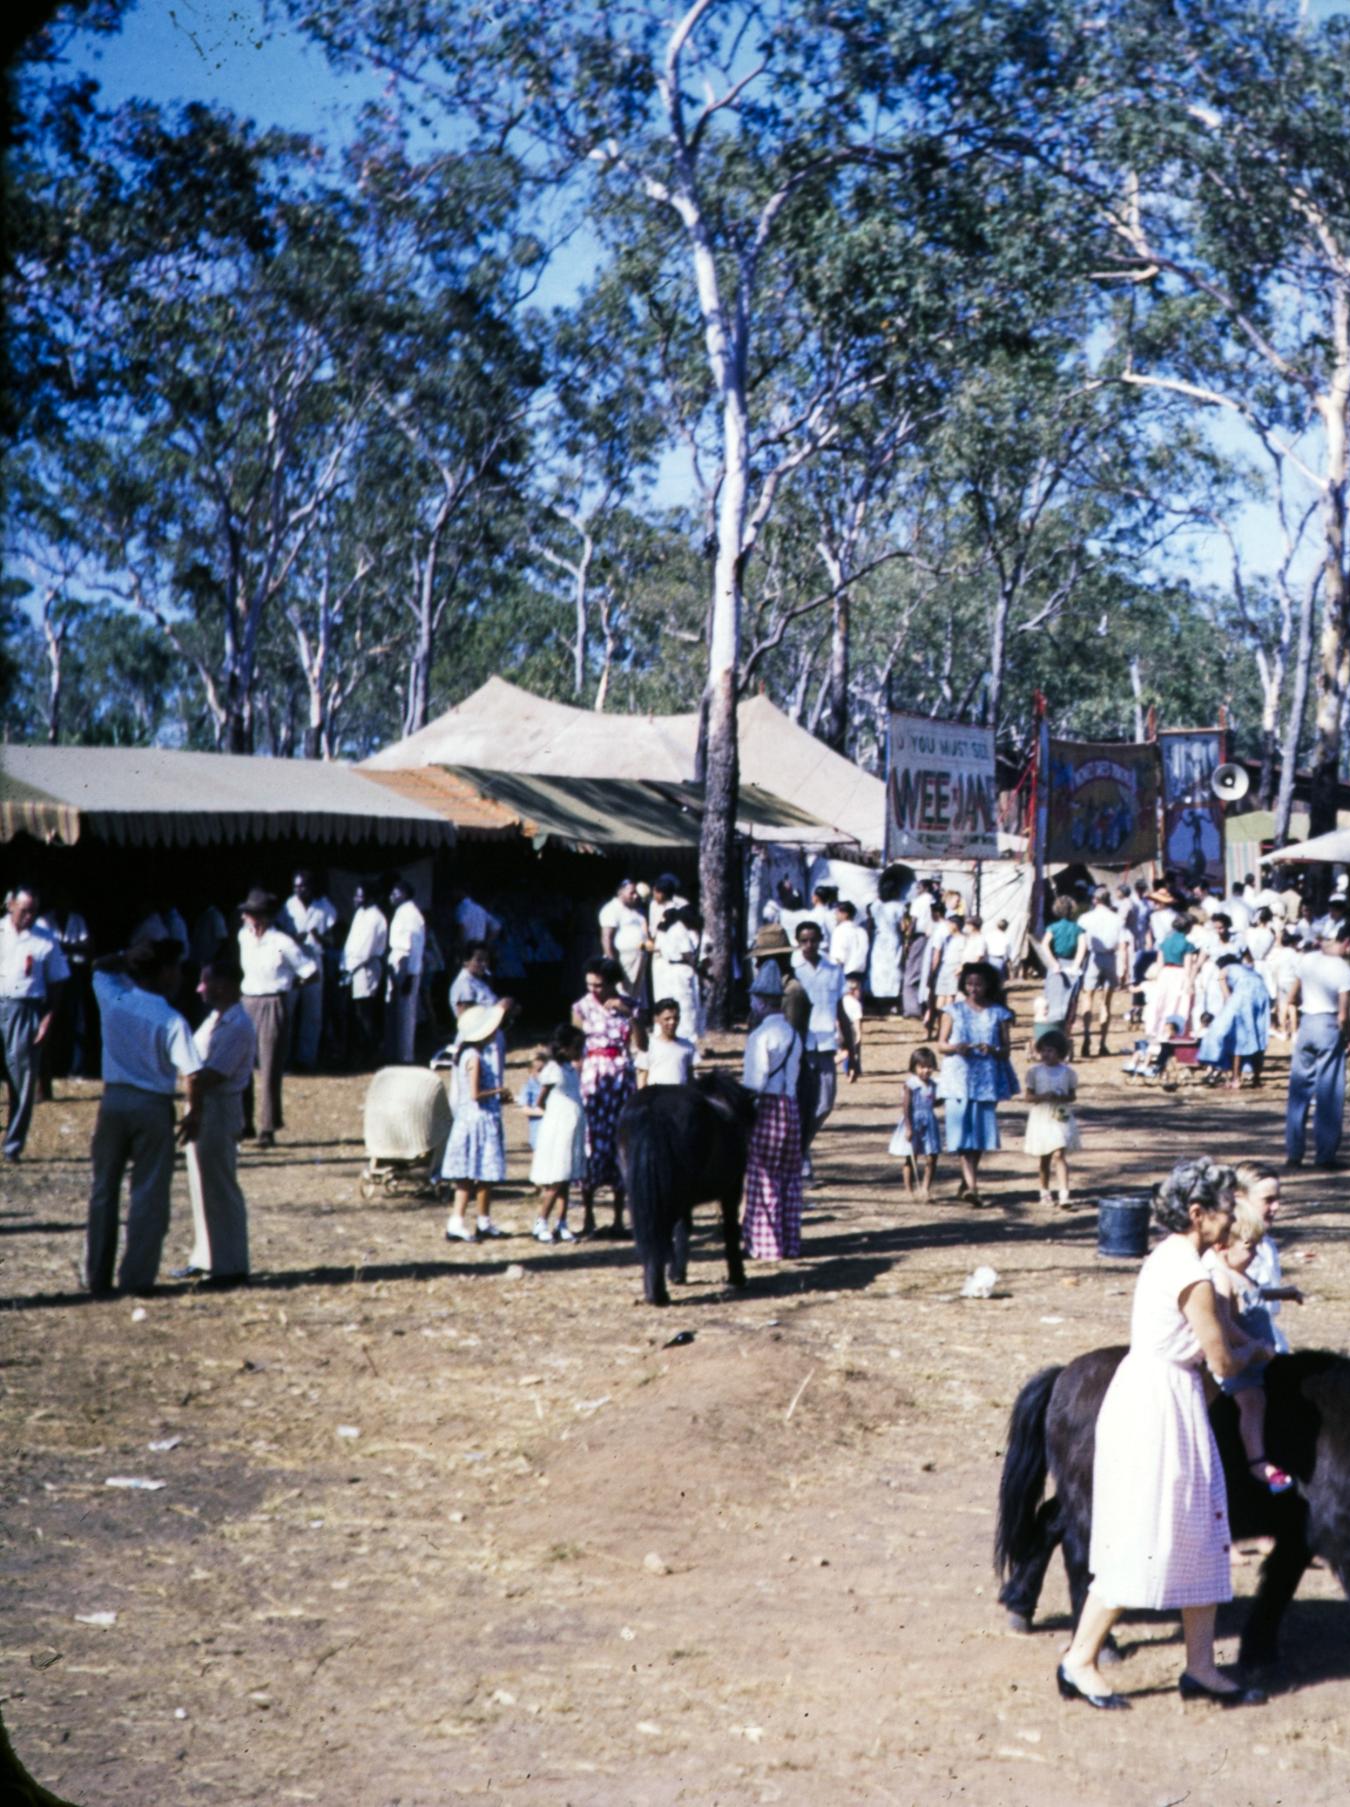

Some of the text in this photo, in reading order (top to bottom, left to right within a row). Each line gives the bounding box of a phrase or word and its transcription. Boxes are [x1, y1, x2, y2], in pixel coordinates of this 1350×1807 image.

[911, 735, 935, 754] YOU
[939, 739, 967, 757] MUST
[890, 767, 950, 831] WEE
